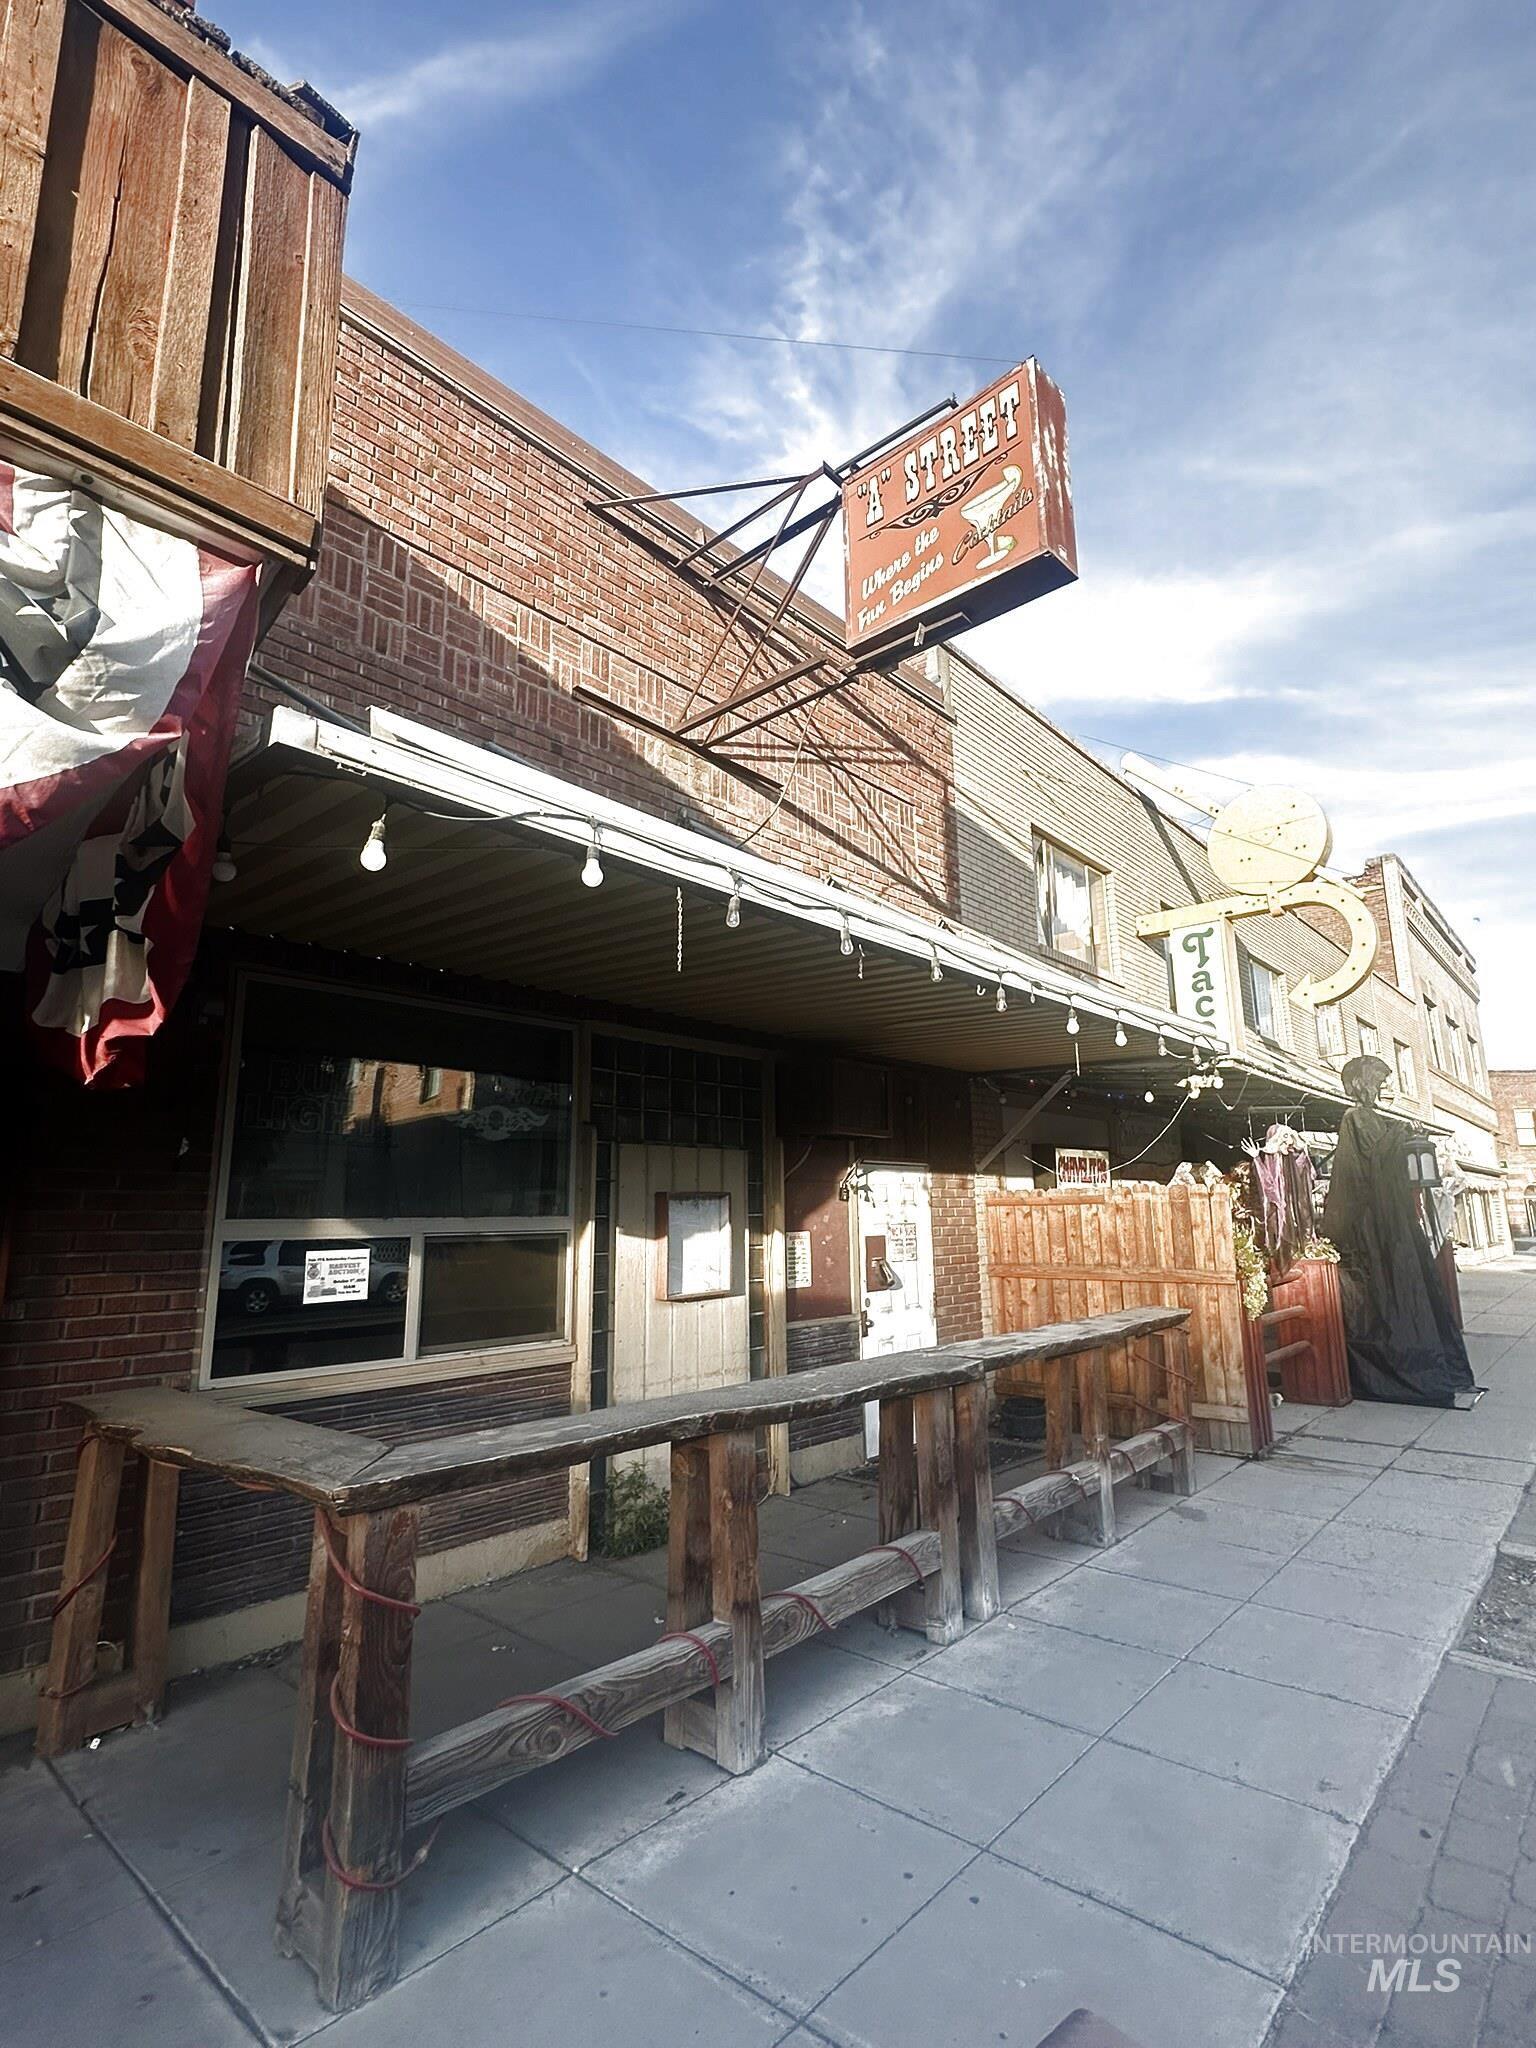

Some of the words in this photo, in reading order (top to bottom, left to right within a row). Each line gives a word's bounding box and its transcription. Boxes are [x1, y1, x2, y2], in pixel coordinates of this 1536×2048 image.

[903, 380, 1020, 504] STREET
[861, 552, 911, 600] Where
[914, 527, 940, 552] the
[951, 487, 1033, 565] Cocktails
[857, 602, 886, 632] Fun
[889, 551, 944, 606] Begins
[1181, 926, 1216, 1029] Tac
